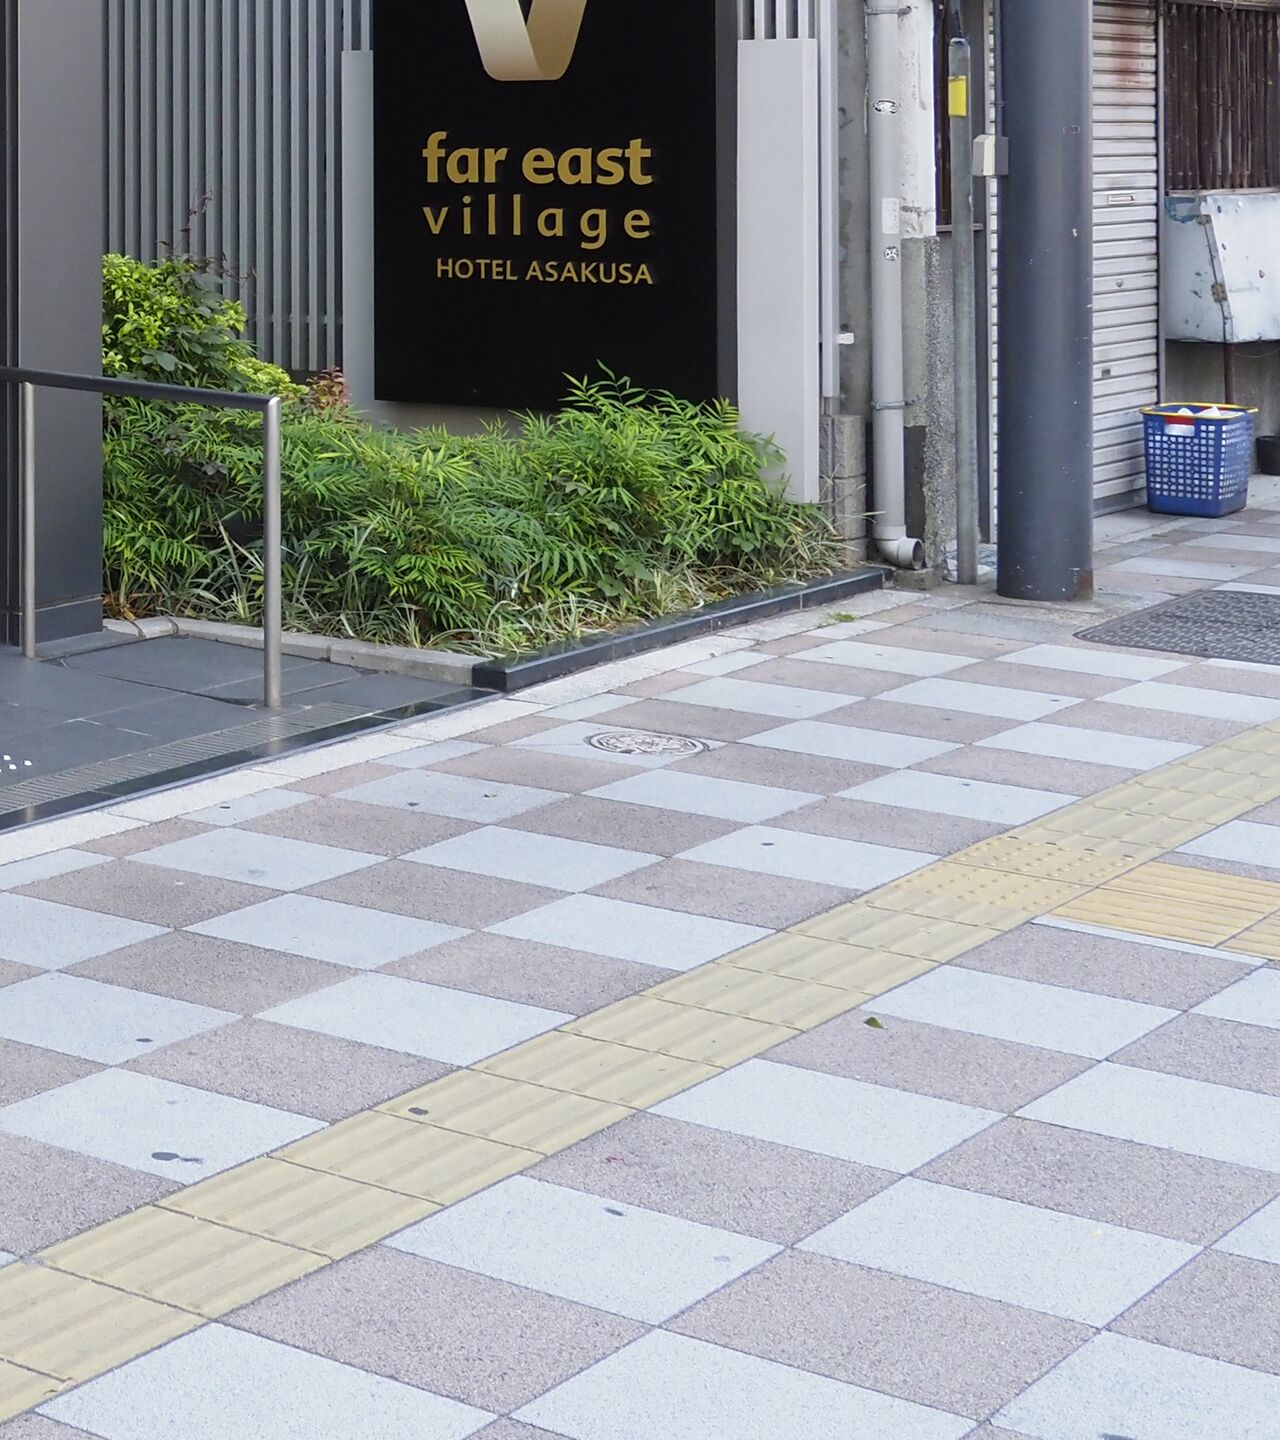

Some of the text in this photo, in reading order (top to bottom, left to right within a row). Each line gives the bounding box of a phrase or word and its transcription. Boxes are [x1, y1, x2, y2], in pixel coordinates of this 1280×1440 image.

[422, 131, 653, 185] far east
[422, 193, 652, 249] village
[437, 258, 654, 284] HOTEL ASAKUSA
